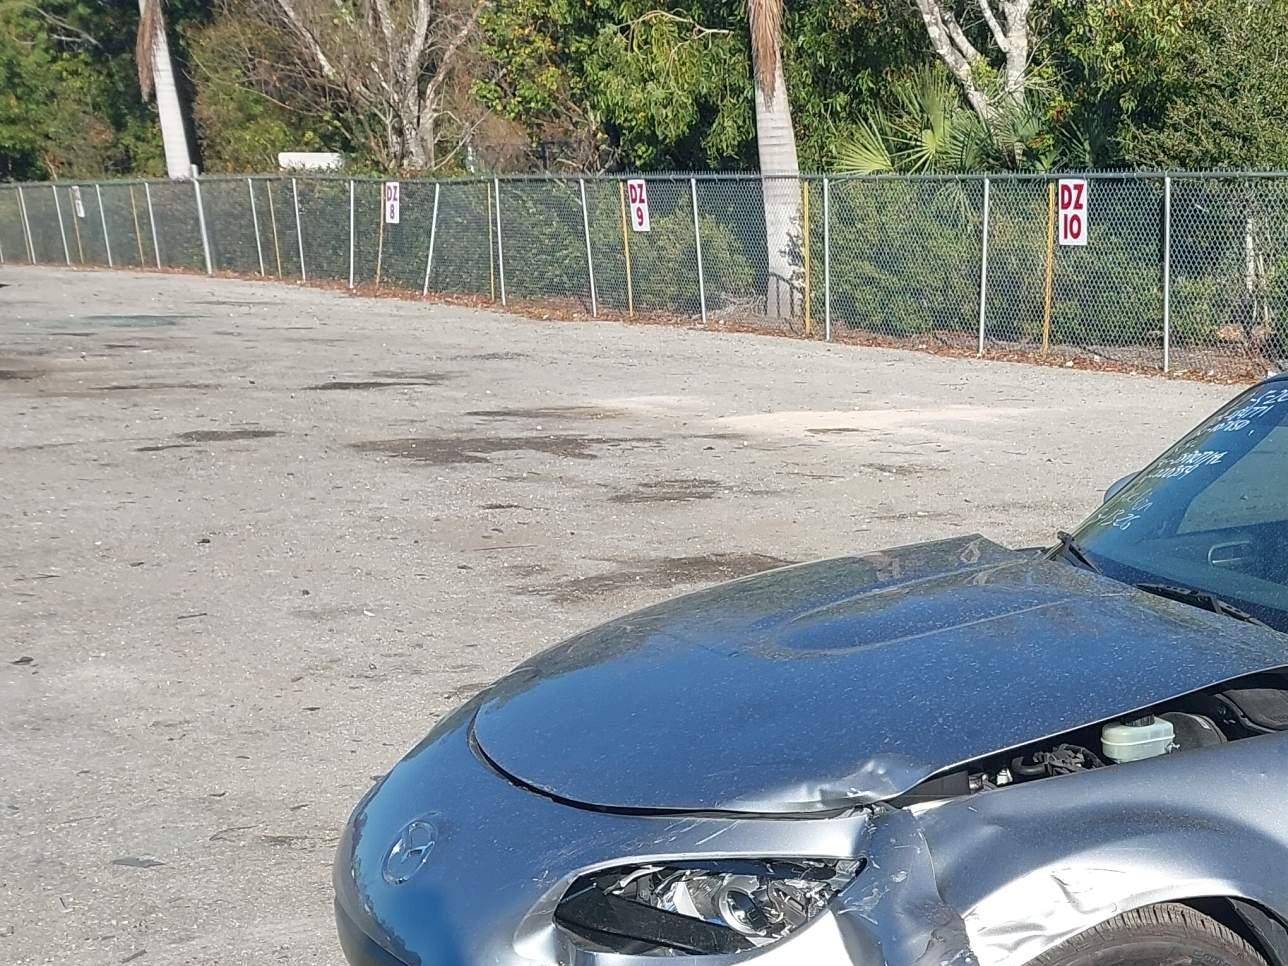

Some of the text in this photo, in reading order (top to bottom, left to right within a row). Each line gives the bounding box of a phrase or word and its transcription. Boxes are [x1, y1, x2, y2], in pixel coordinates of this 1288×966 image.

[387, 185, 398, 202] DZ
[629, 183, 646, 204] DZ
[1060, 183, 1085, 211] DZ
[636, 206, 644, 227] 9
[1063, 213, 1082, 240] 10
